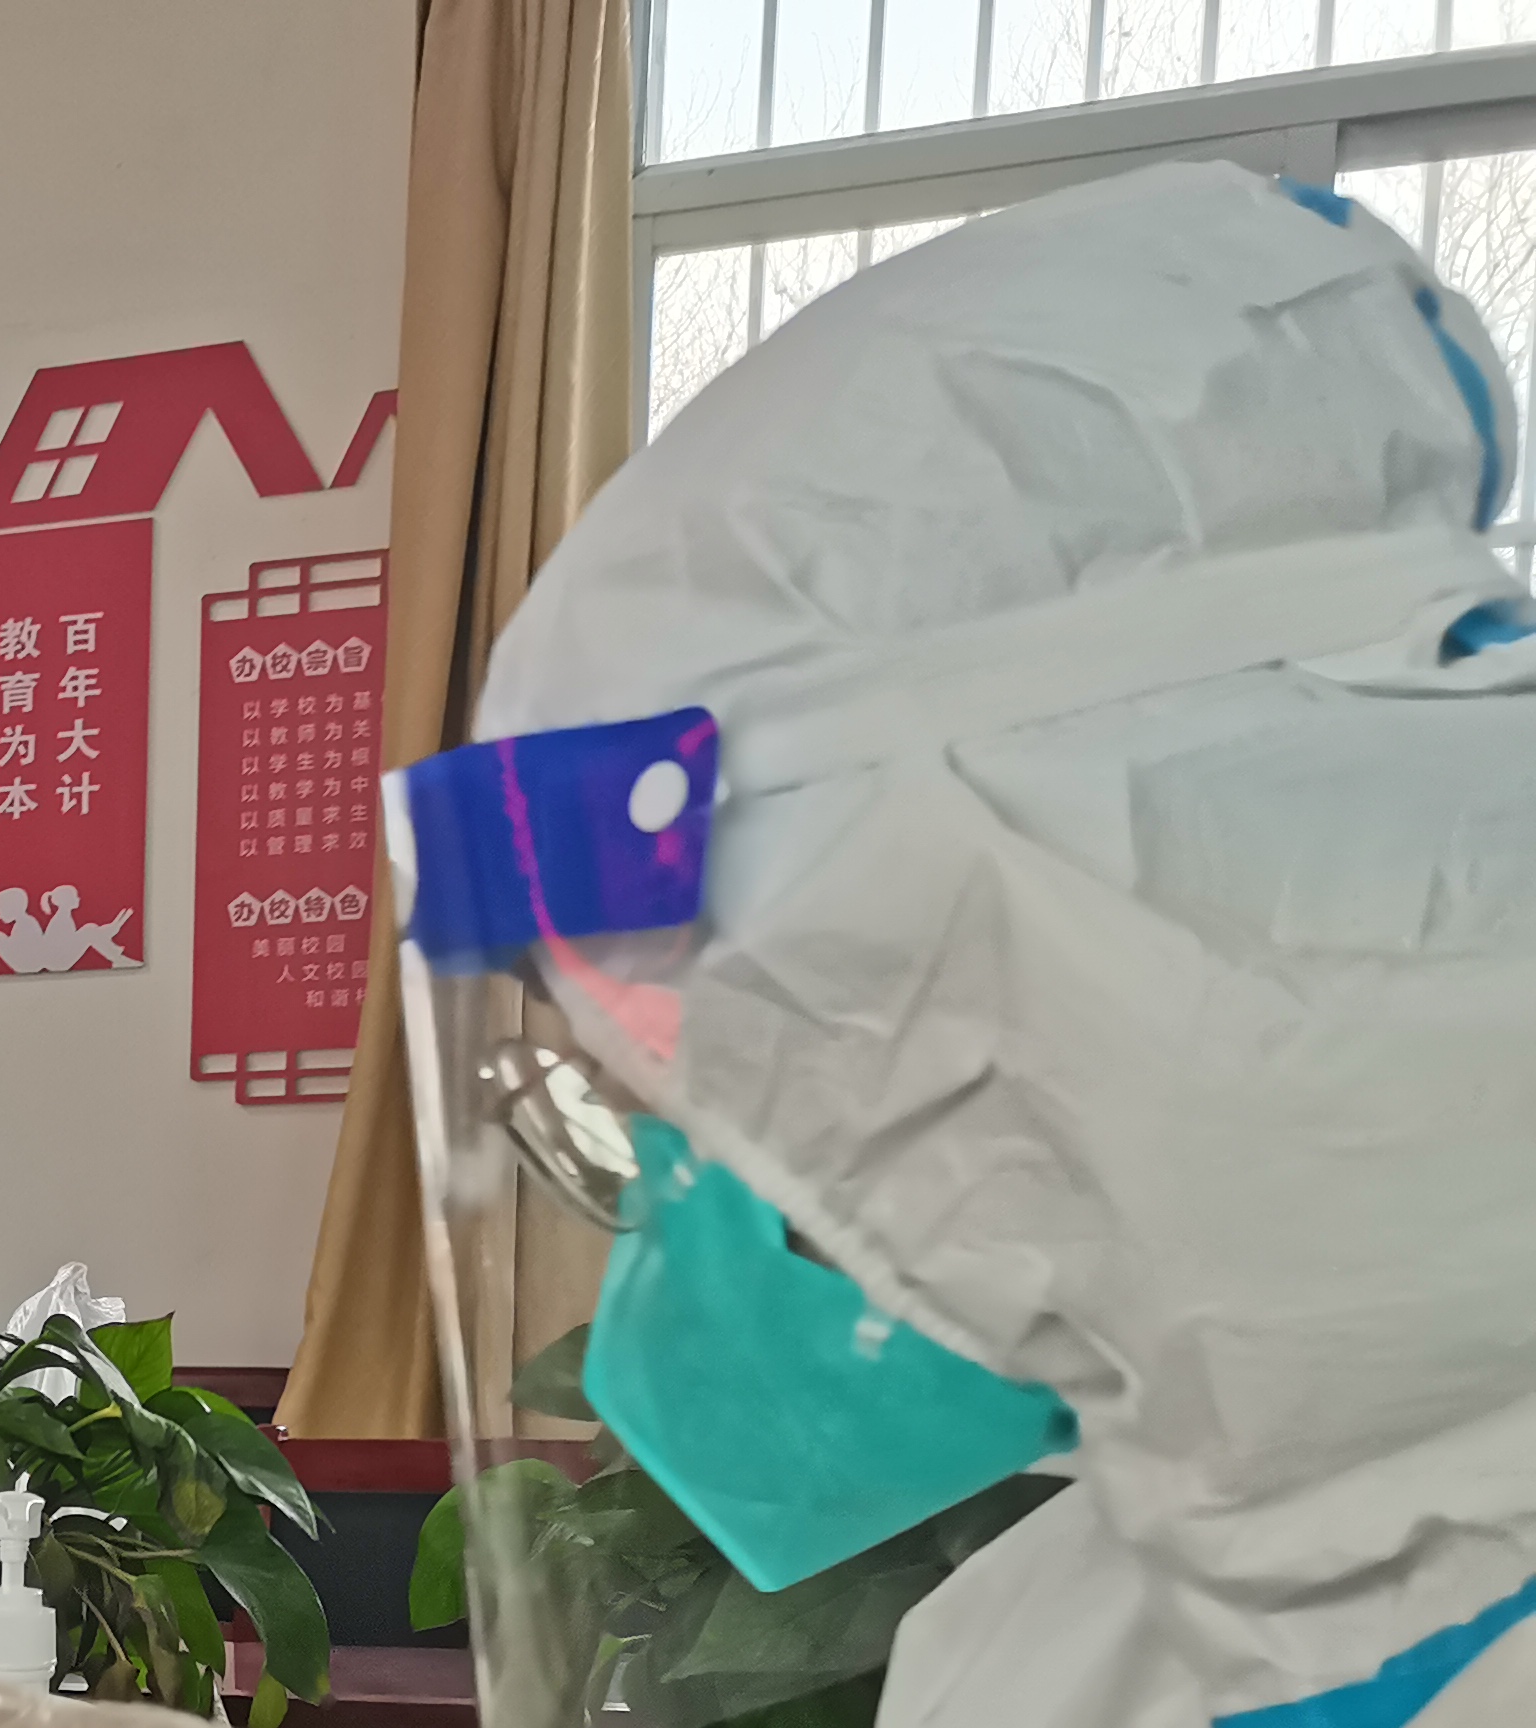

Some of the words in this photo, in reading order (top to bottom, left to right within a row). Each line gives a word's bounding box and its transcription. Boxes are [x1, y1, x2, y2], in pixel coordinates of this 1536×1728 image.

[234, 642, 366, 679] 办校宗旨
[54, 610, 106, 818] 百年大计
[242, 690, 372, 721] 以学校为基
[241, 719, 372, 748] 以教师为关
[241, 746, 371, 776] 以学生为根
[240, 775, 370, 803] 以教学为中
[239, 803, 369, 831] 以质量求生
[238, 831, 368, 858] 以管理求效
[233, 892, 362, 923] 办校特色
[251, 933, 347, 959] 美丽校园
[275, 959, 369, 984] 人文校园
